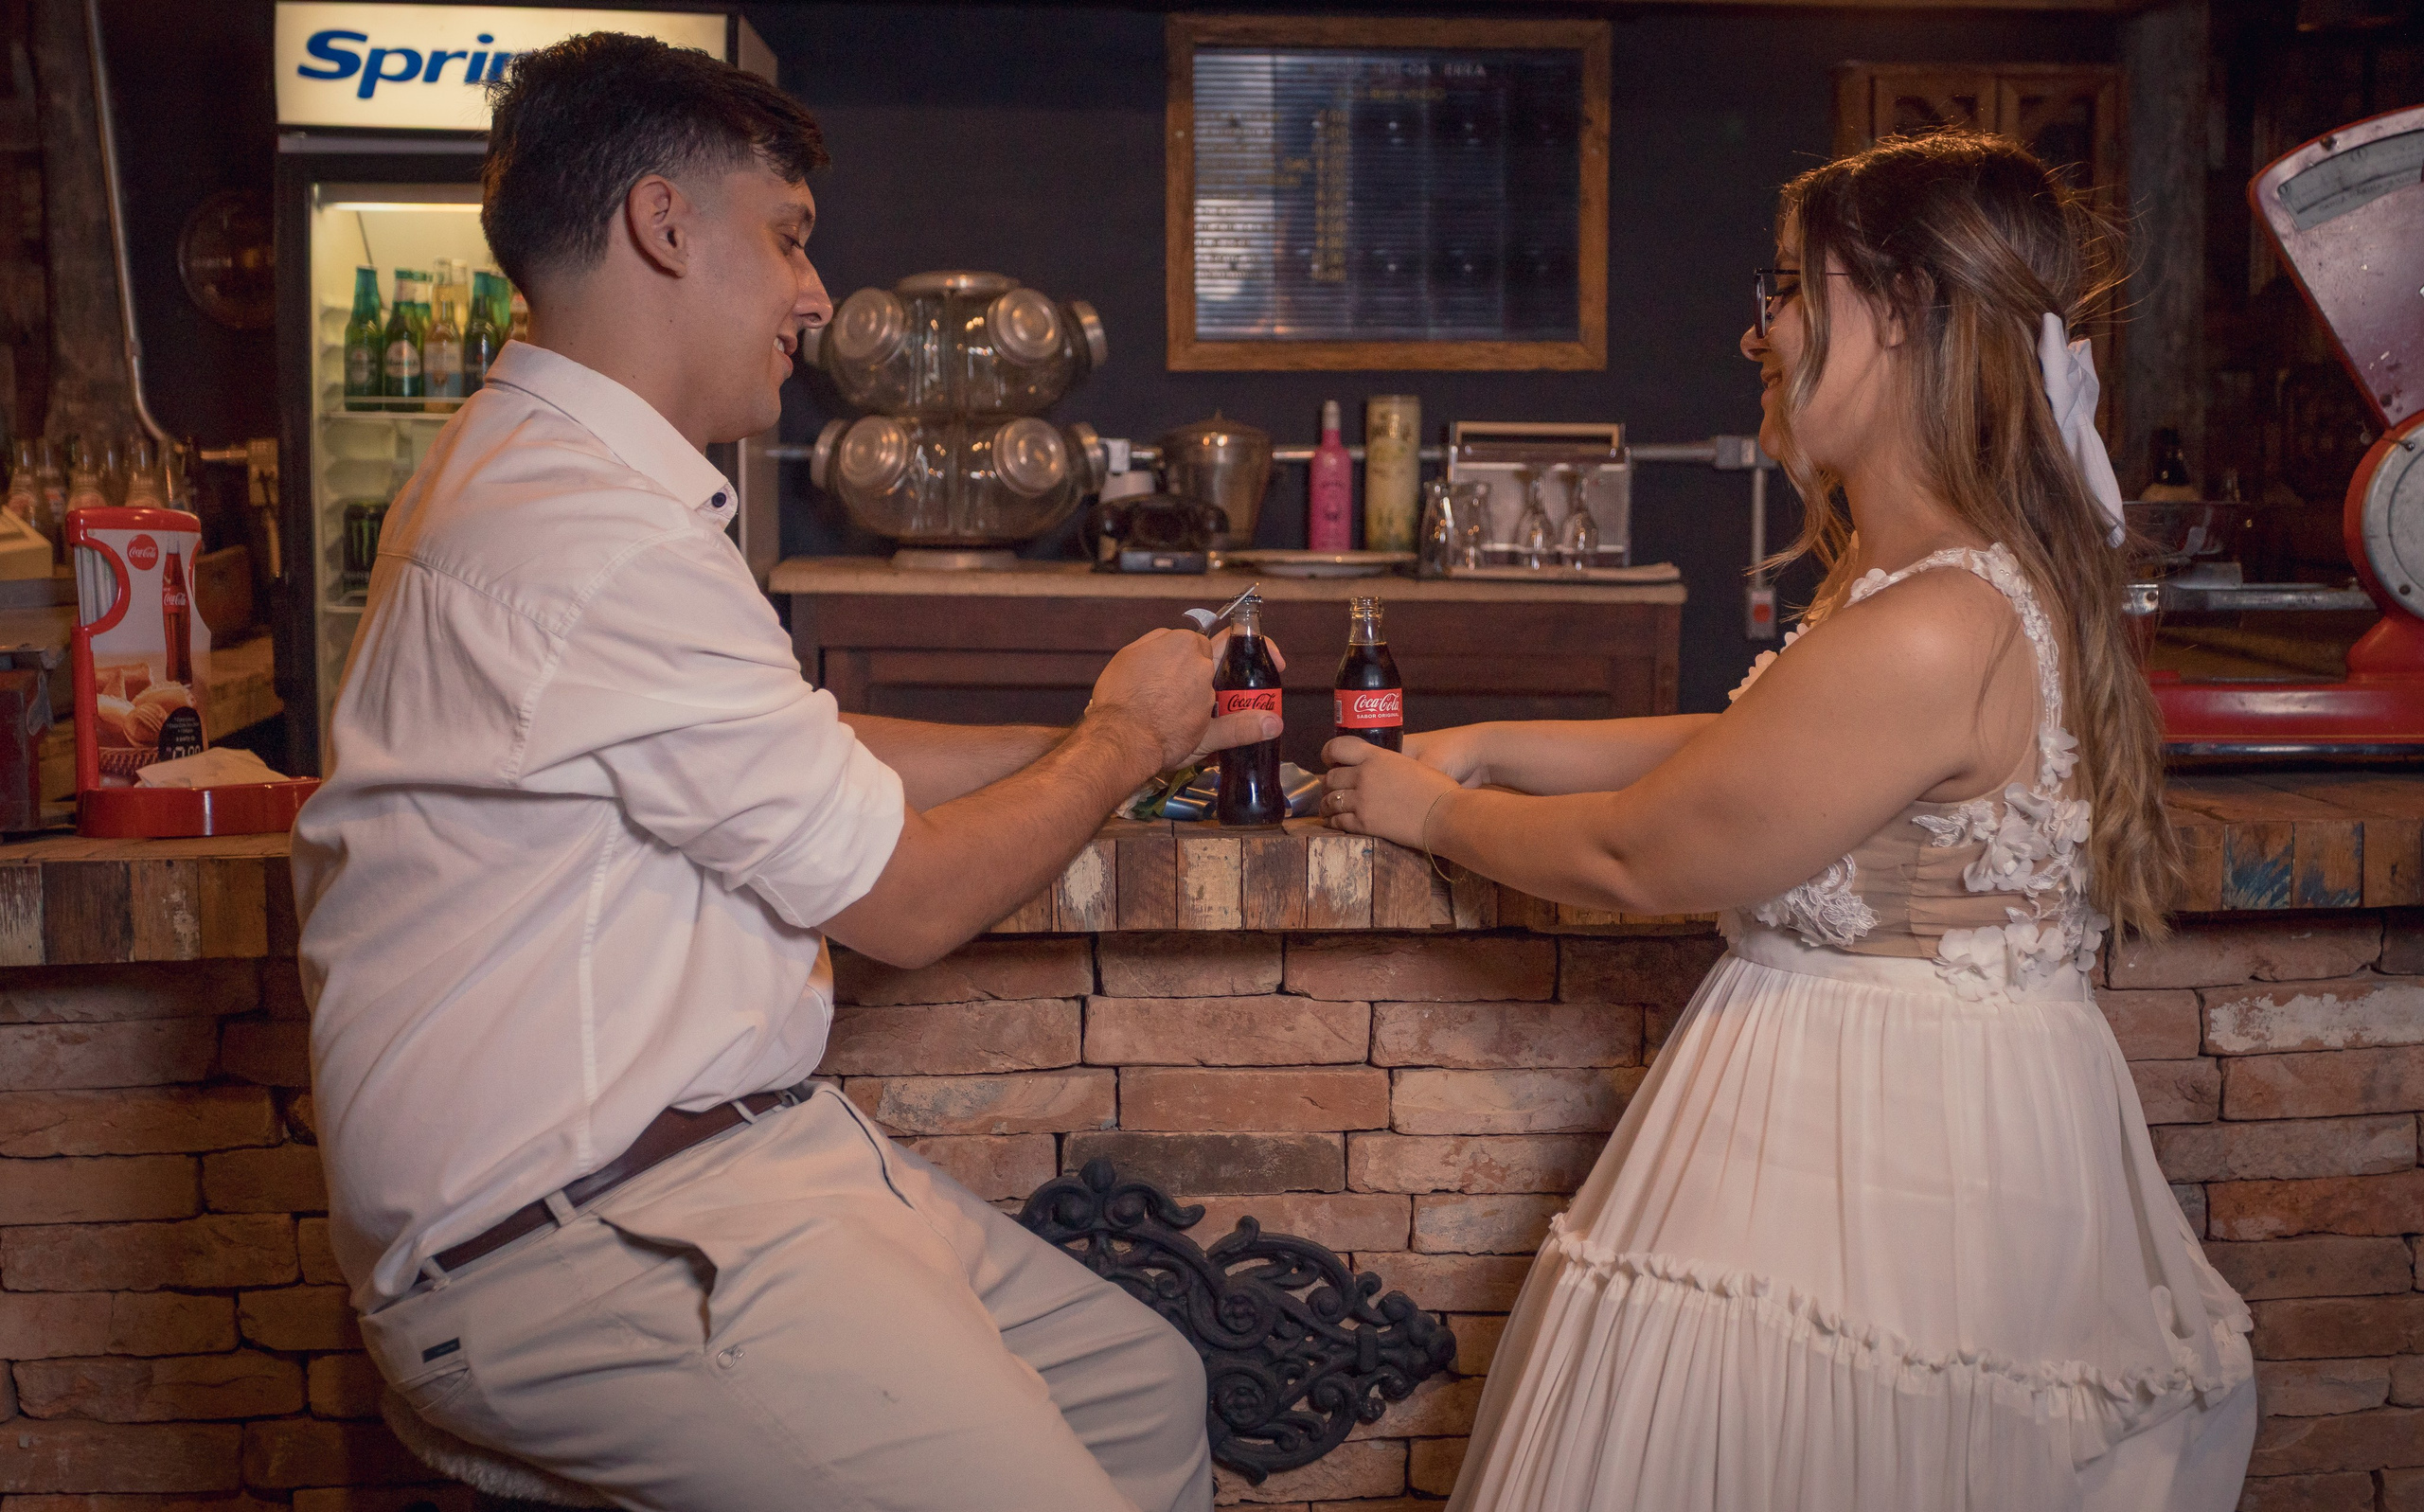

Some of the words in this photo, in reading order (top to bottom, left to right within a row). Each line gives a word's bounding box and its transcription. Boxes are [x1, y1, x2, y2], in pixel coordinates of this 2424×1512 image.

[129, 546, 156, 559] Coca-Cola
[1227, 693, 1276, 712] Coca-Cola
[1354, 693, 1400, 713] Coca-Cola
